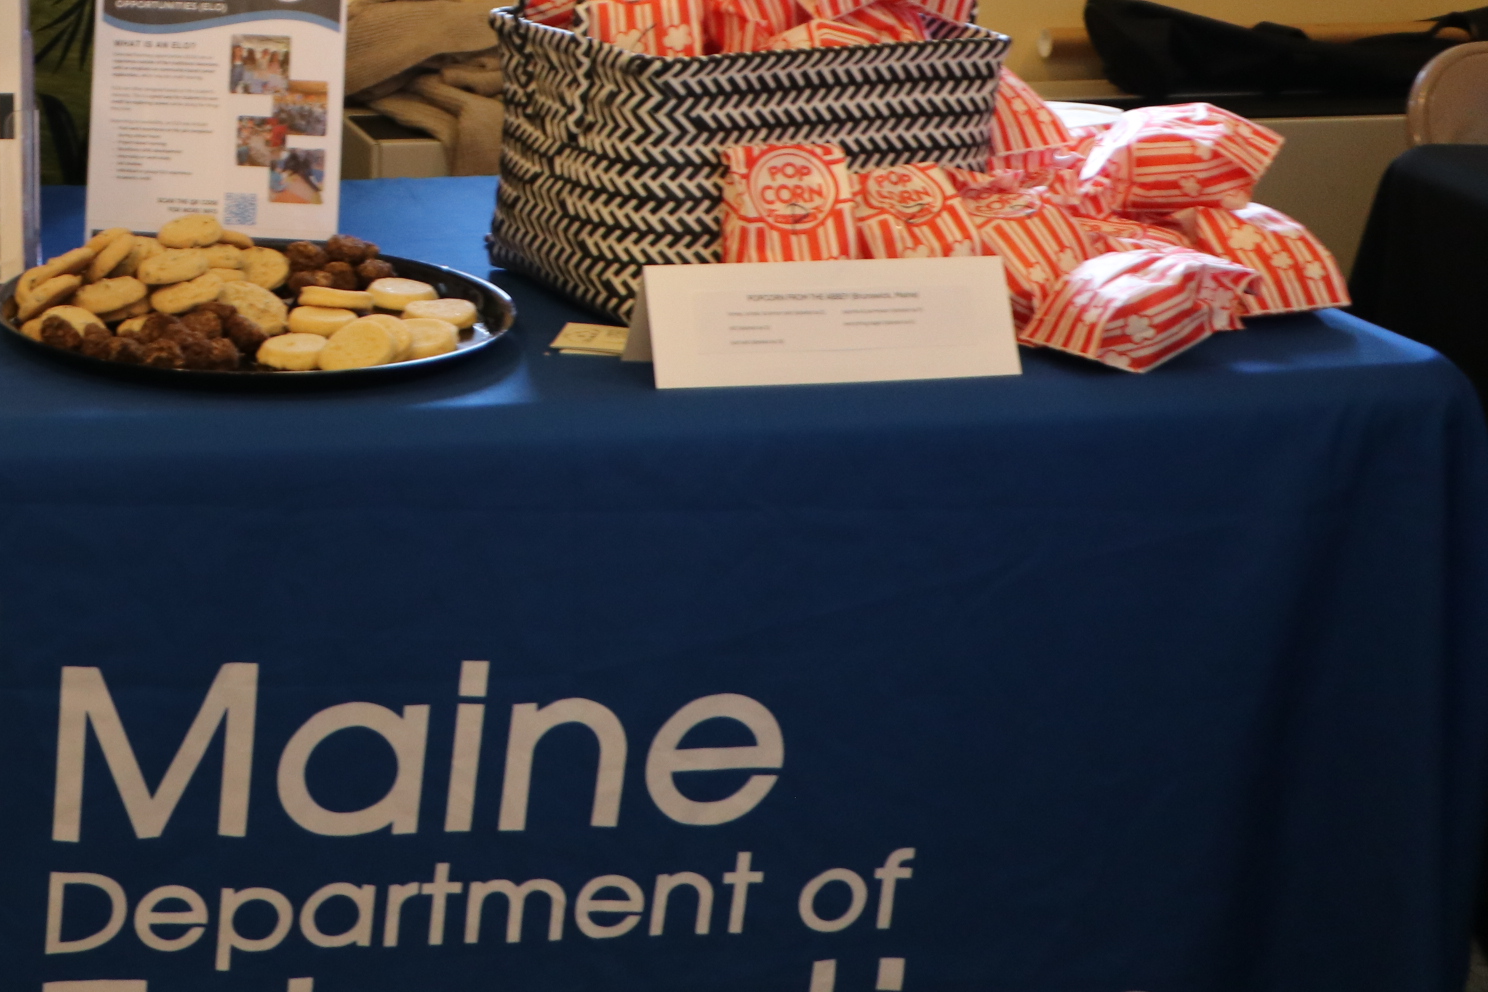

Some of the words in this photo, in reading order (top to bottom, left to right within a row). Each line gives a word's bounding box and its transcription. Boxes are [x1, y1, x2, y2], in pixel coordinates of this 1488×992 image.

[115, 0, 197, 11] OPPORTUNITIES
[768, 162, 811, 181] POP
[875, 171, 912, 187] POP
[762, 183, 825, 205] CORN
[52, 661, 784, 843] Maine
[44, 851, 764, 971] Department
[798, 848, 916, 934] of
